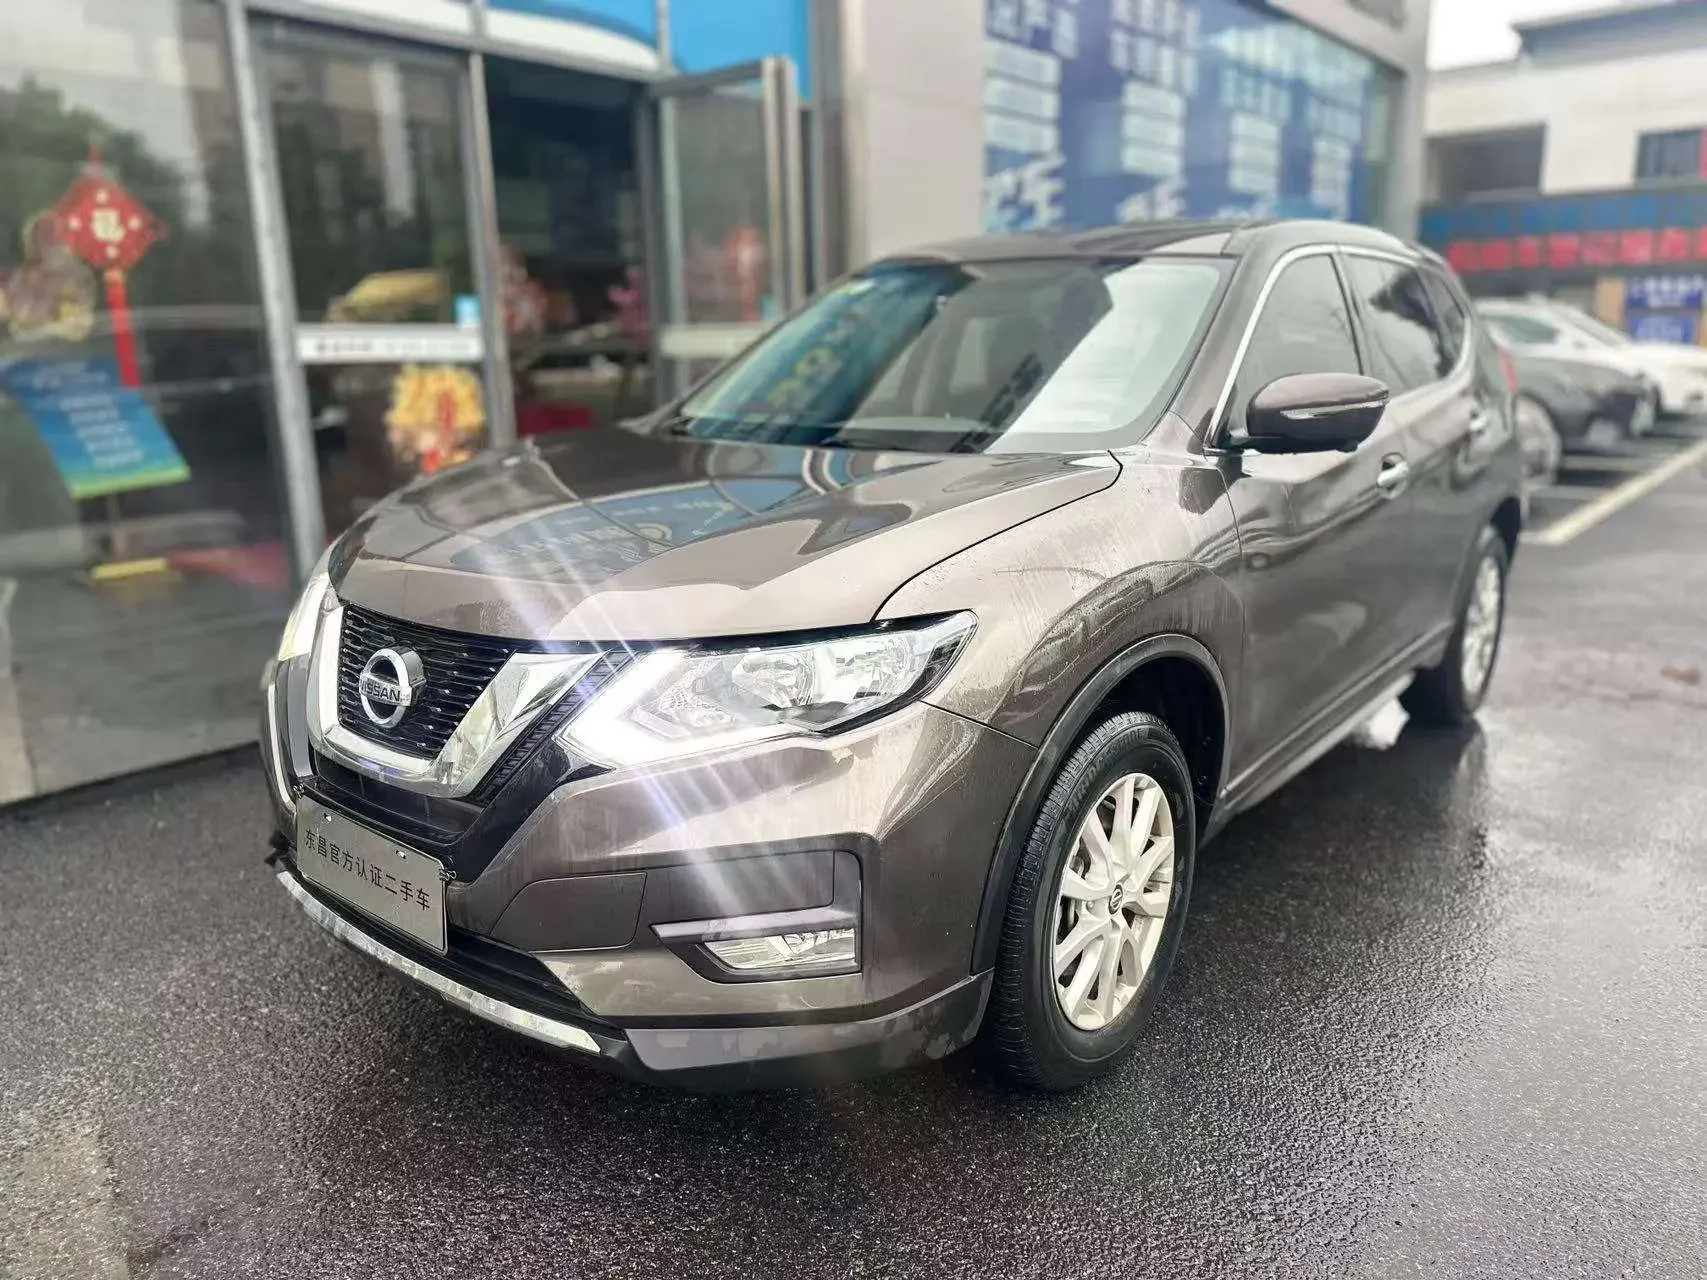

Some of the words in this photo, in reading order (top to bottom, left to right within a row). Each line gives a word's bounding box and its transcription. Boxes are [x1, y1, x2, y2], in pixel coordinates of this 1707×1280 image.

[360, 679, 401, 702] NISSAN
[305, 828, 430, 911] 东昌官方认证二手车
